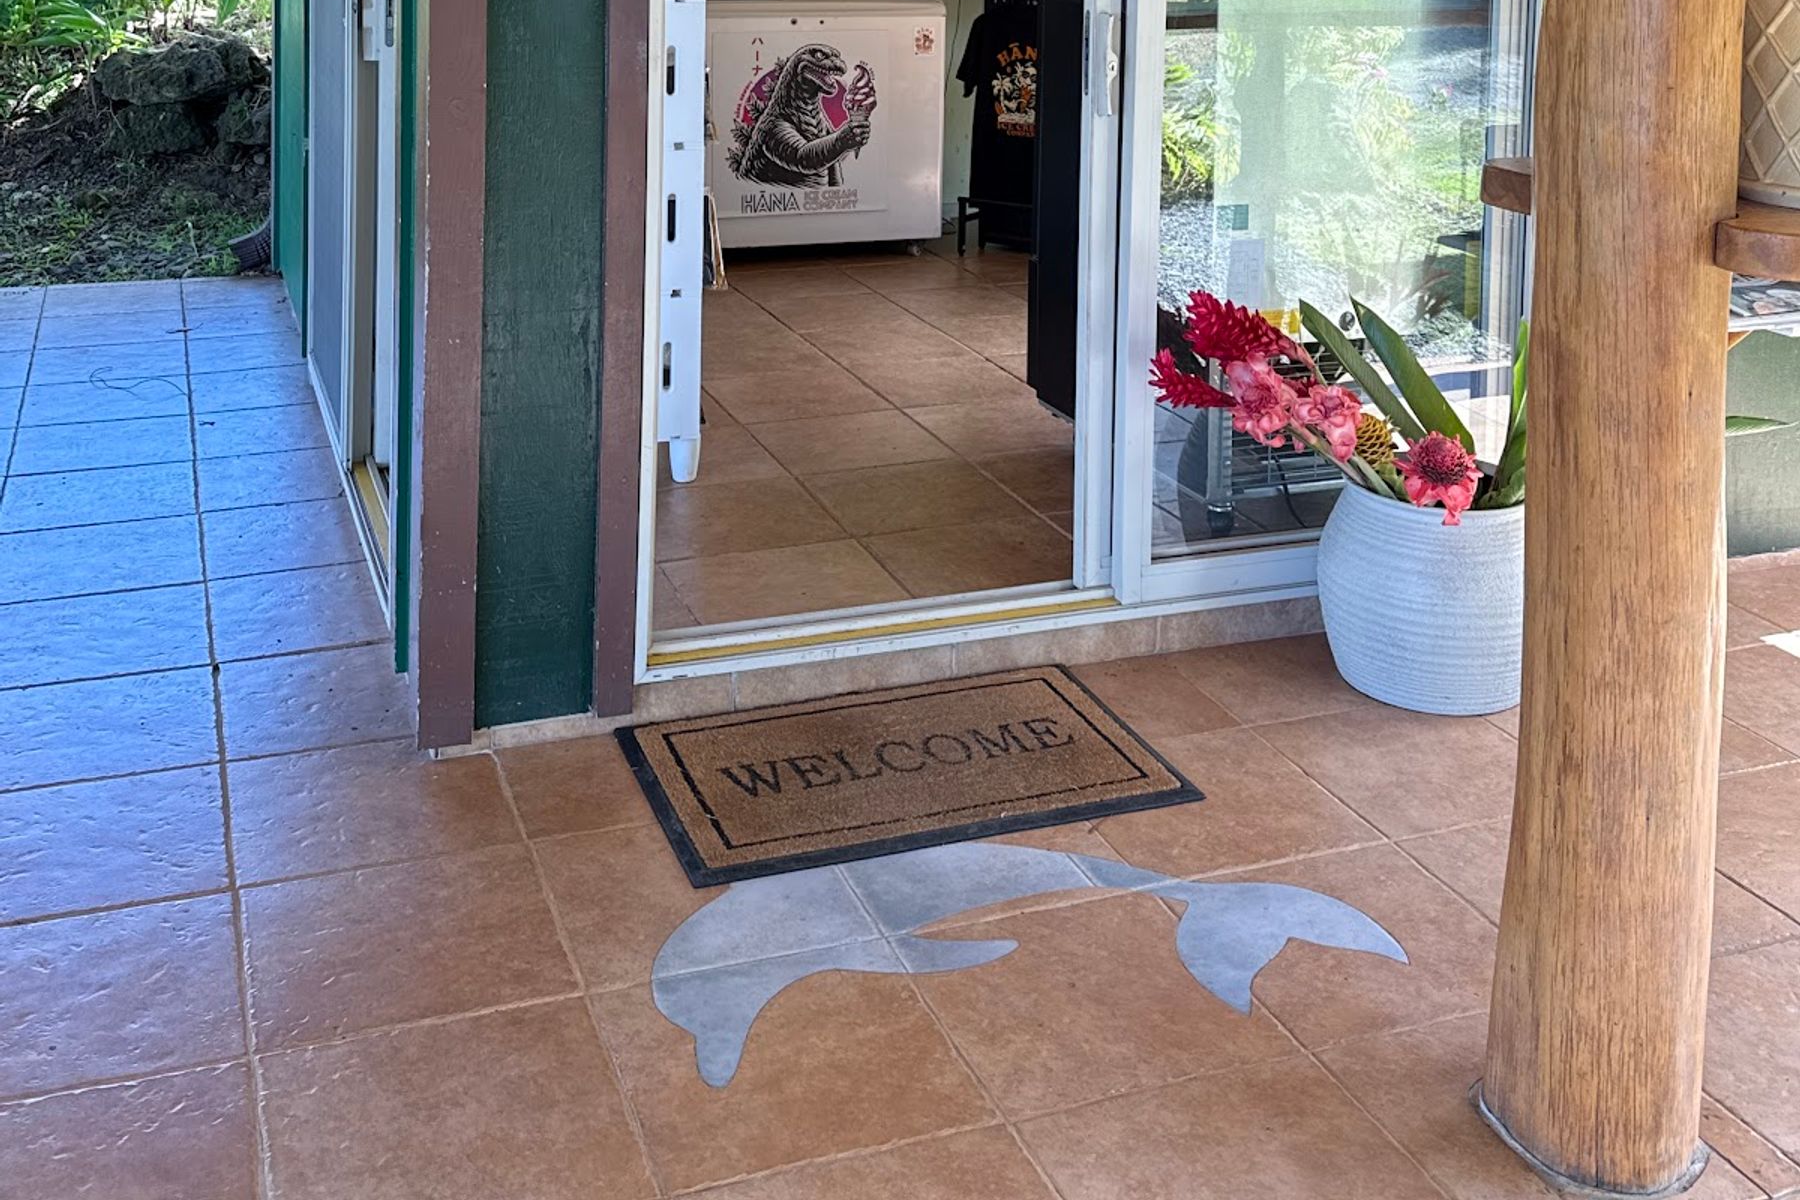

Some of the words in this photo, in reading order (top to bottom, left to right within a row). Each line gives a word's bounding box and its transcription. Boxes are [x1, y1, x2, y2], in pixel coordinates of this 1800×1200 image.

[997, 42, 1038, 67] HĀN
[741, 190, 800, 213] HĀNA
[717, 716, 1074, 798] WELCOME
